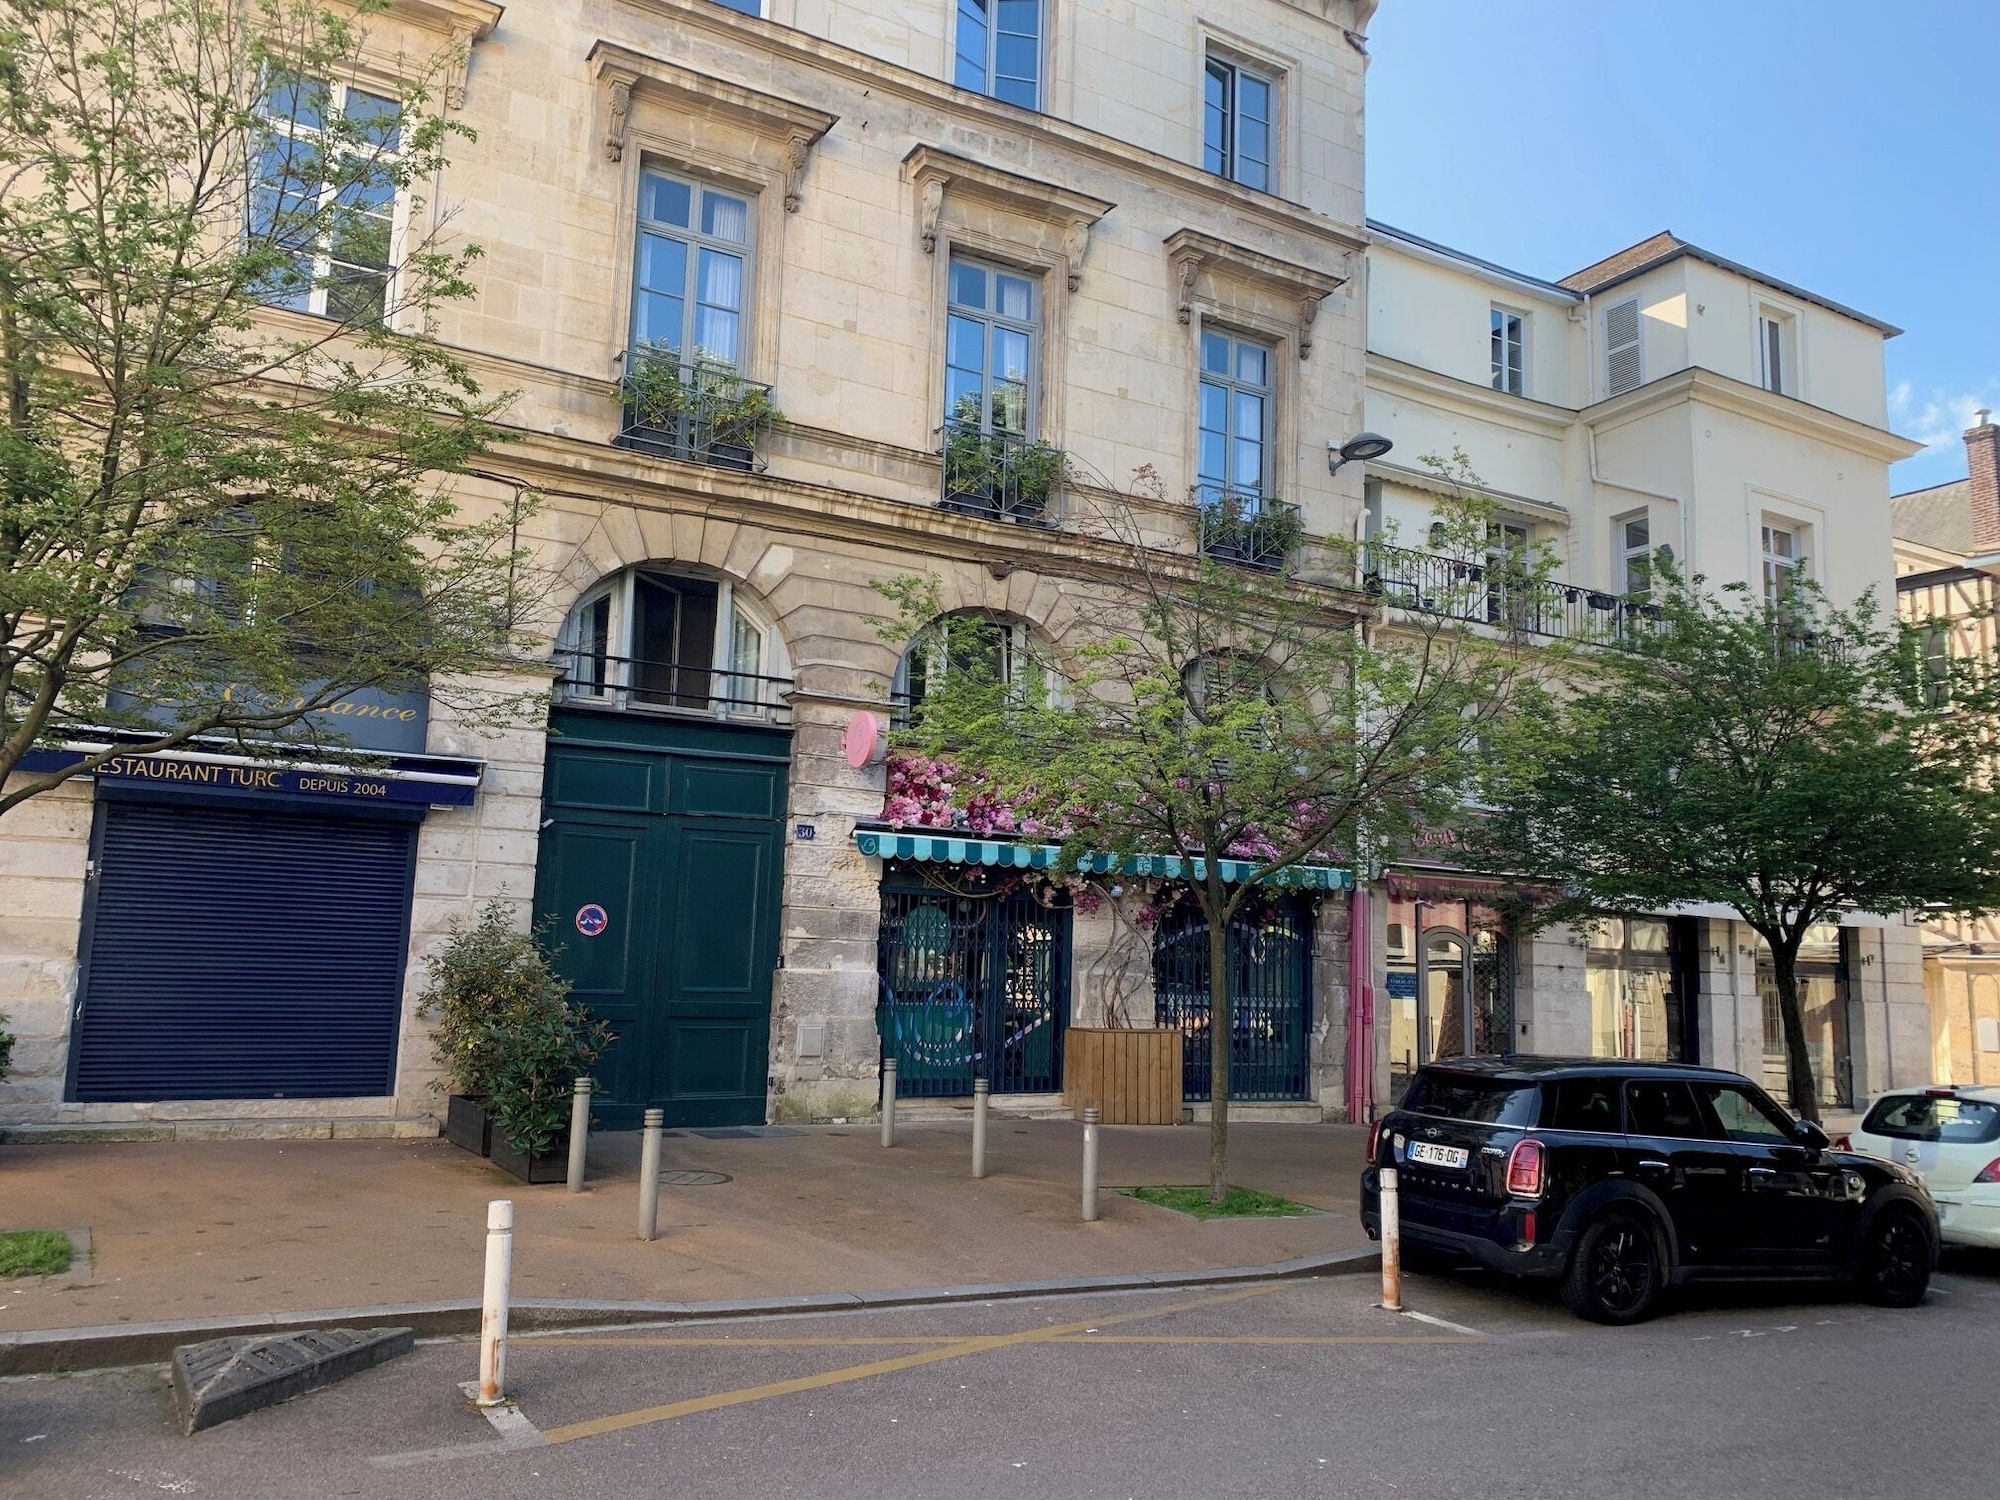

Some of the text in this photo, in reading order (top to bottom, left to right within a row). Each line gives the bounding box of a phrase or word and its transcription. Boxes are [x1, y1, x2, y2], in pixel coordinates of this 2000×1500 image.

[227, 767, 281, 788] TURC
[299, 777, 349, 793] DEPUIS
[353, 782, 387, 796] 2004
[798, 827, 813, 838] 30
[1414, 1144, 1459, 1164] GE-176-DG
